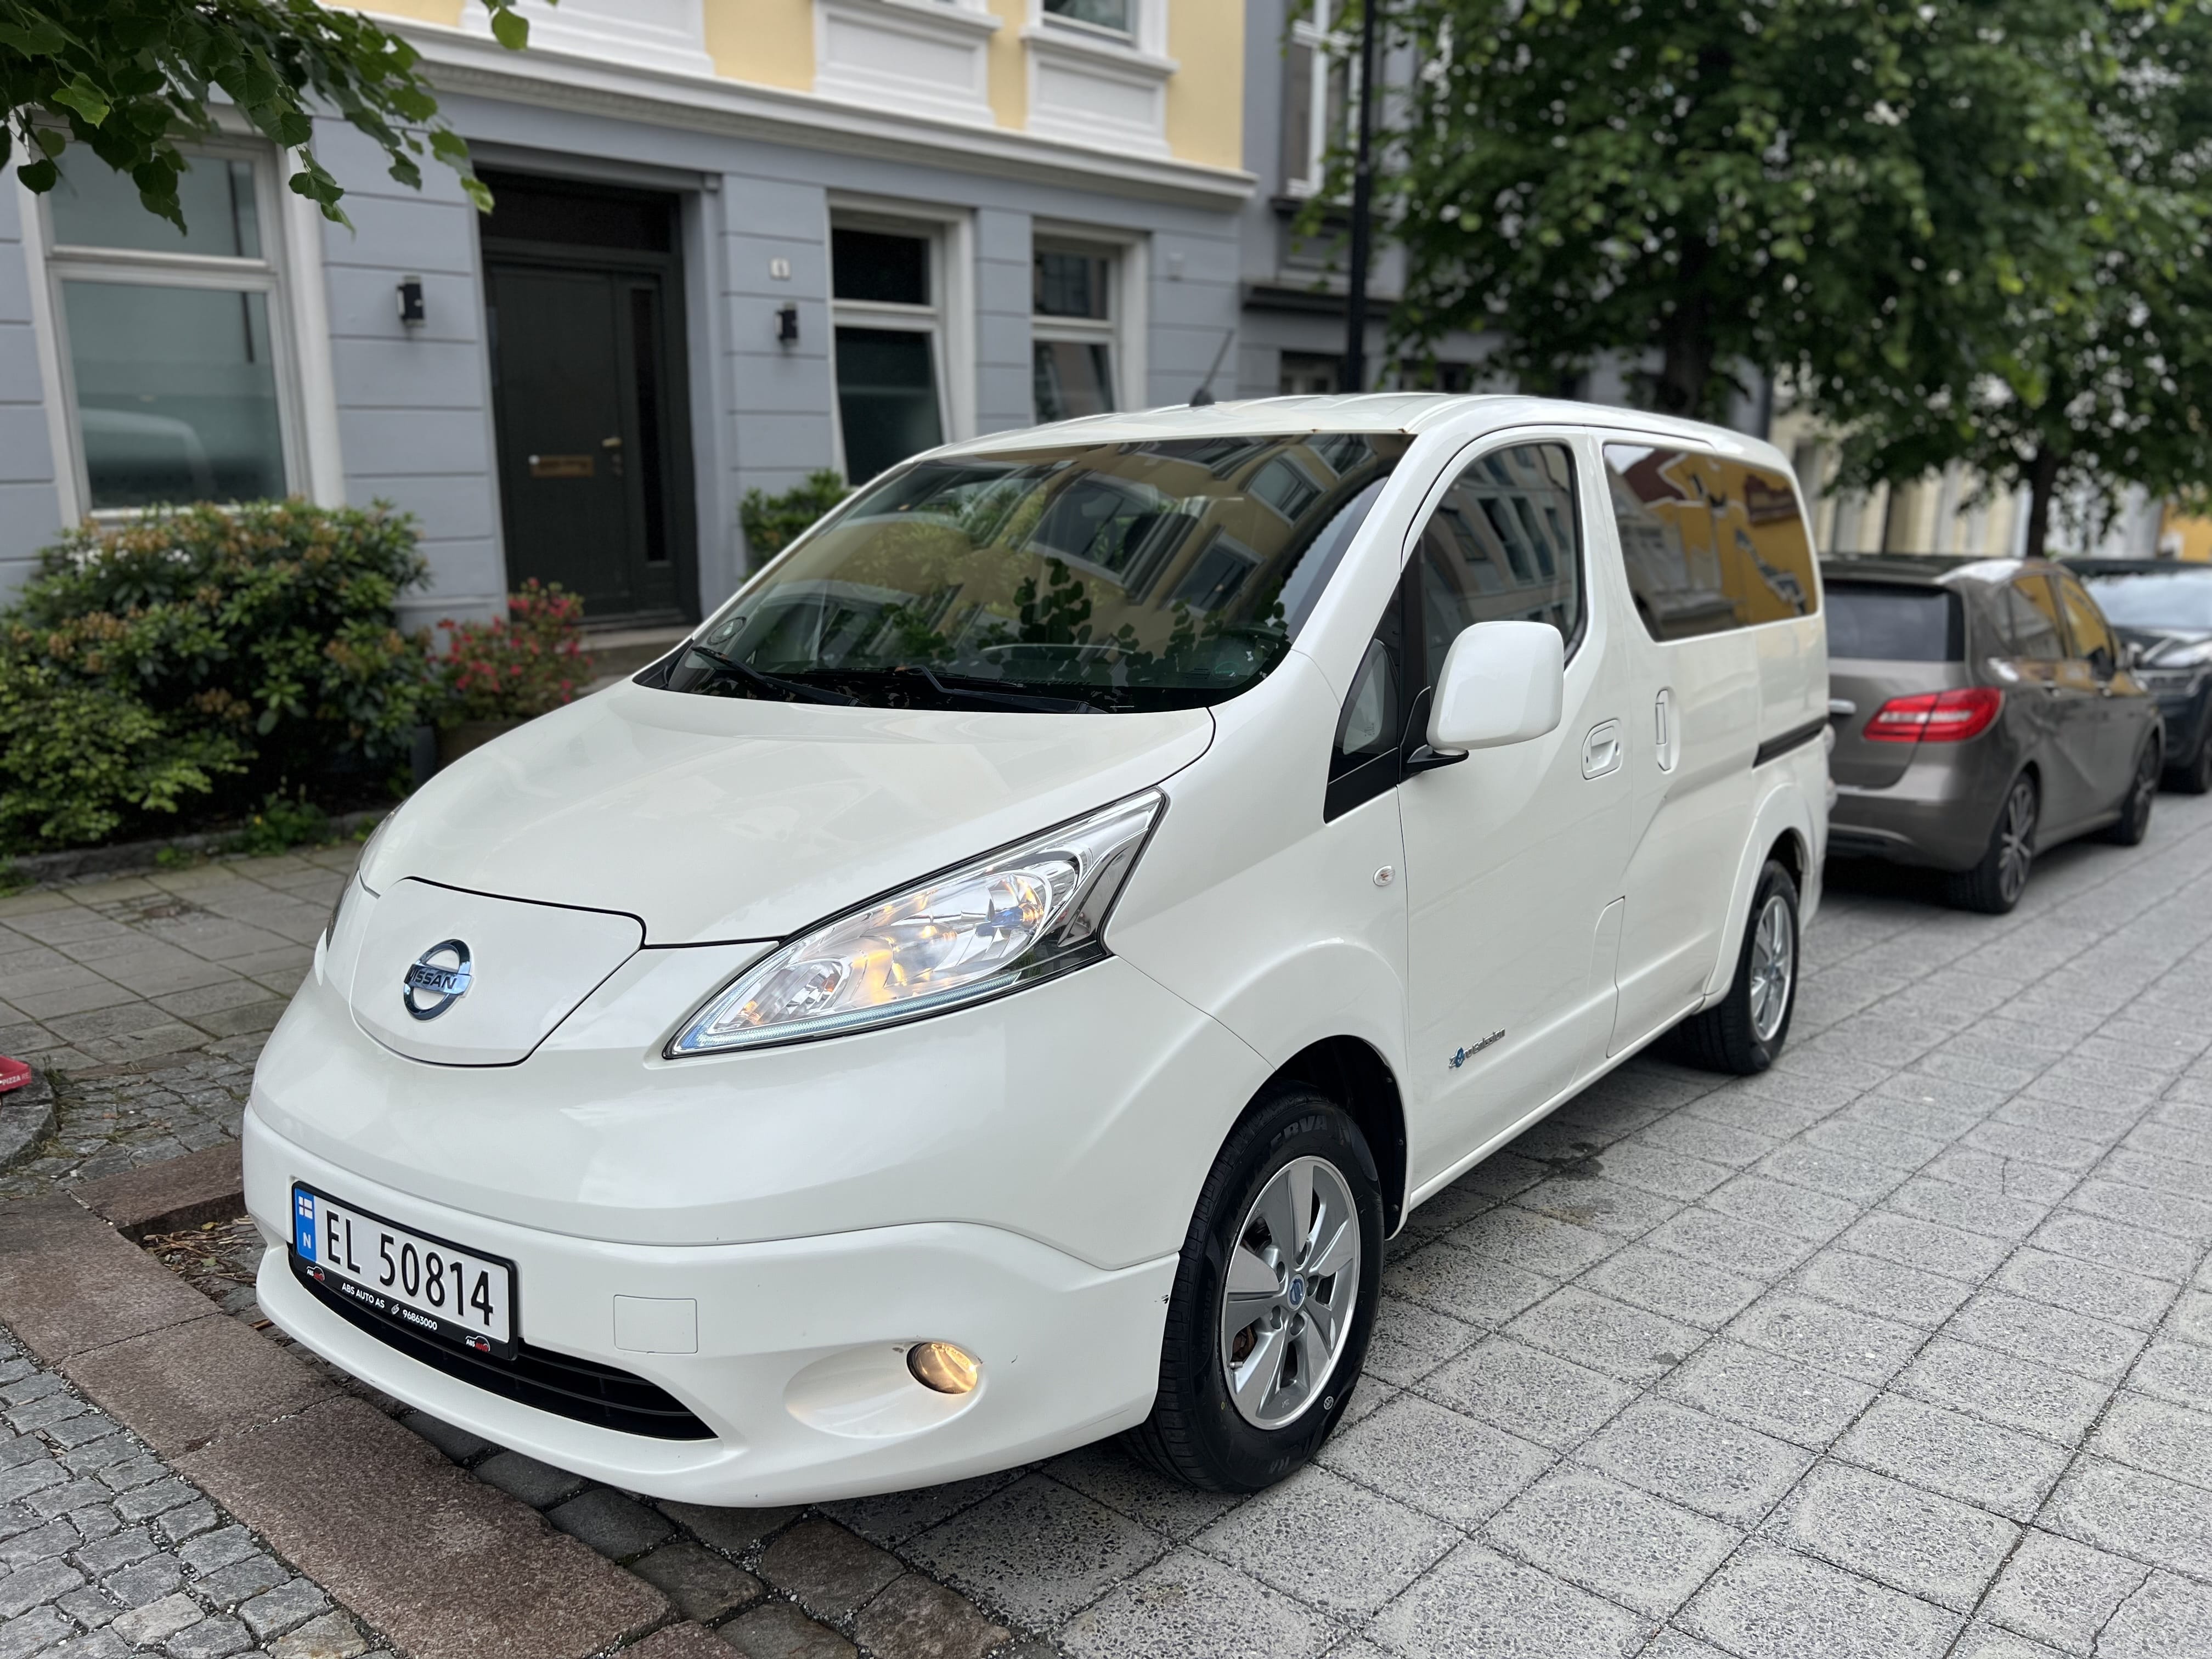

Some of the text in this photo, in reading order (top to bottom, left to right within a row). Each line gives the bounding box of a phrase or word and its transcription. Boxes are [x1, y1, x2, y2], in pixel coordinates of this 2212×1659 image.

[408, 969, 457, 989] NISSAN
[2, 1075, 21, 1086] PIZZA
[303, 1232, 312, 1249] N
[326, 1210, 494, 1326] EL 50814
[341, 1282, 385, 1308] ABS AUTO AS
[402, 1309, 437, 1330] 96863000
[466, 1339, 475, 1347] ABS
